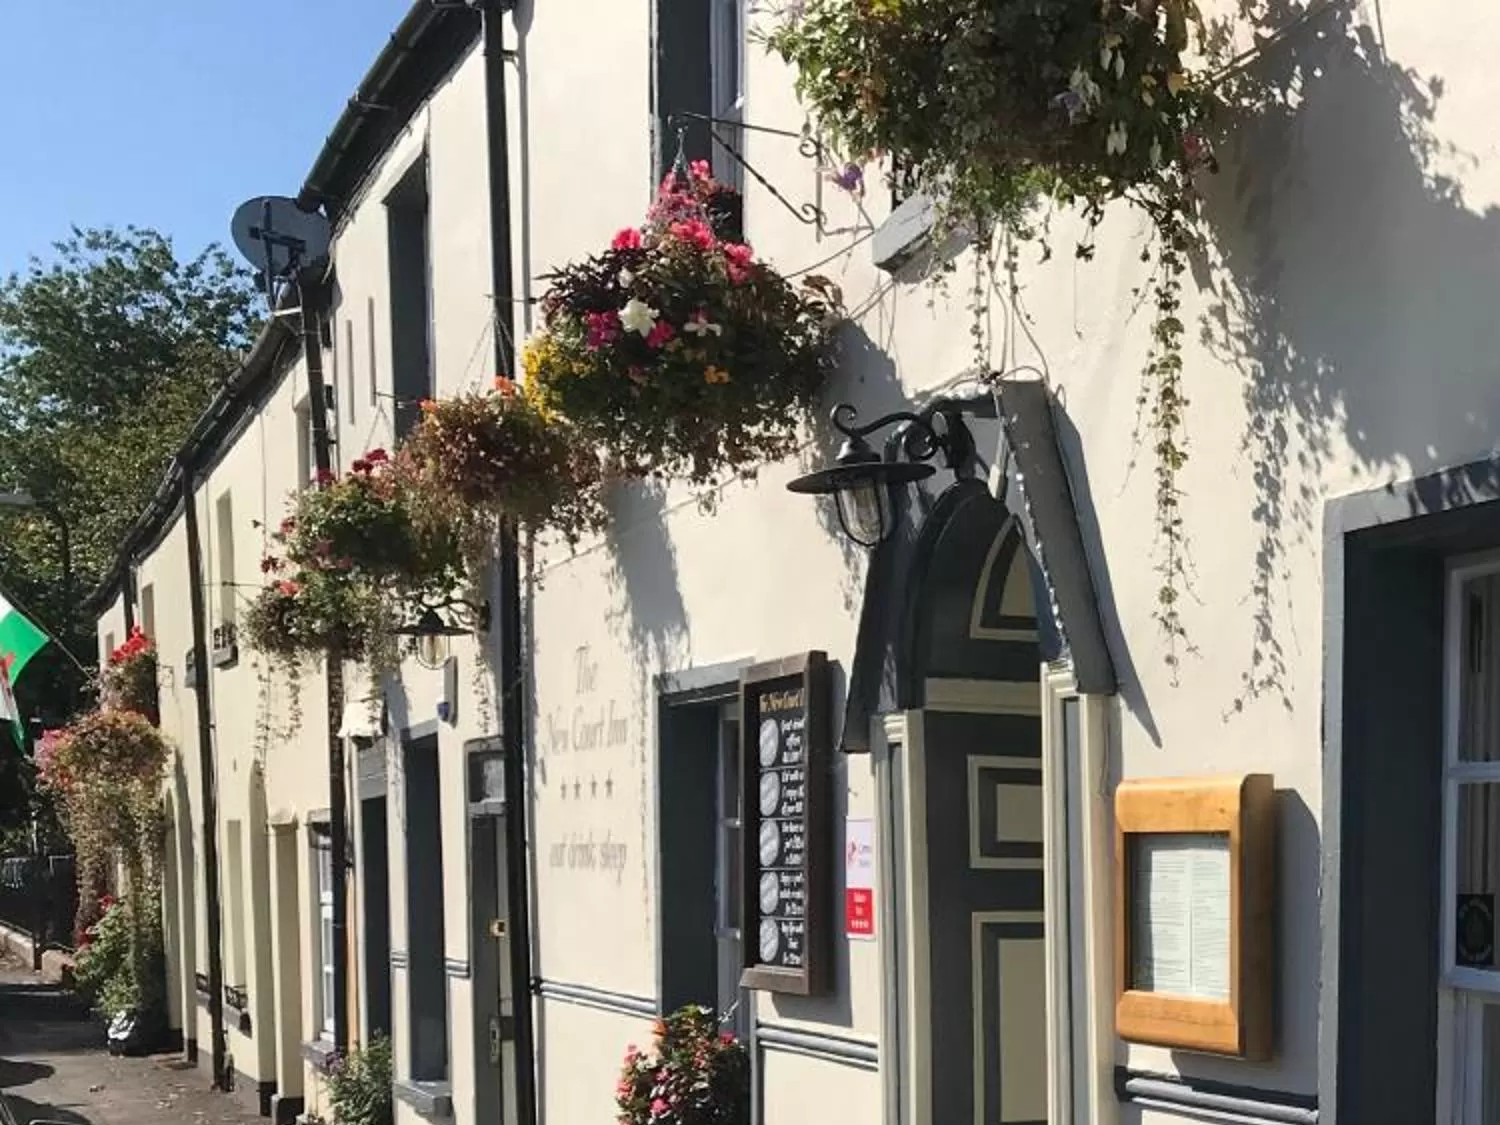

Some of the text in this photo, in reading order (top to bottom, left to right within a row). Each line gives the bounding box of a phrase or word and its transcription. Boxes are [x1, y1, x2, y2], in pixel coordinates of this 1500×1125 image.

[575, 641, 599, 695] The
[571, 702, 605, 752] Court
[606, 699, 628, 748] Inn
